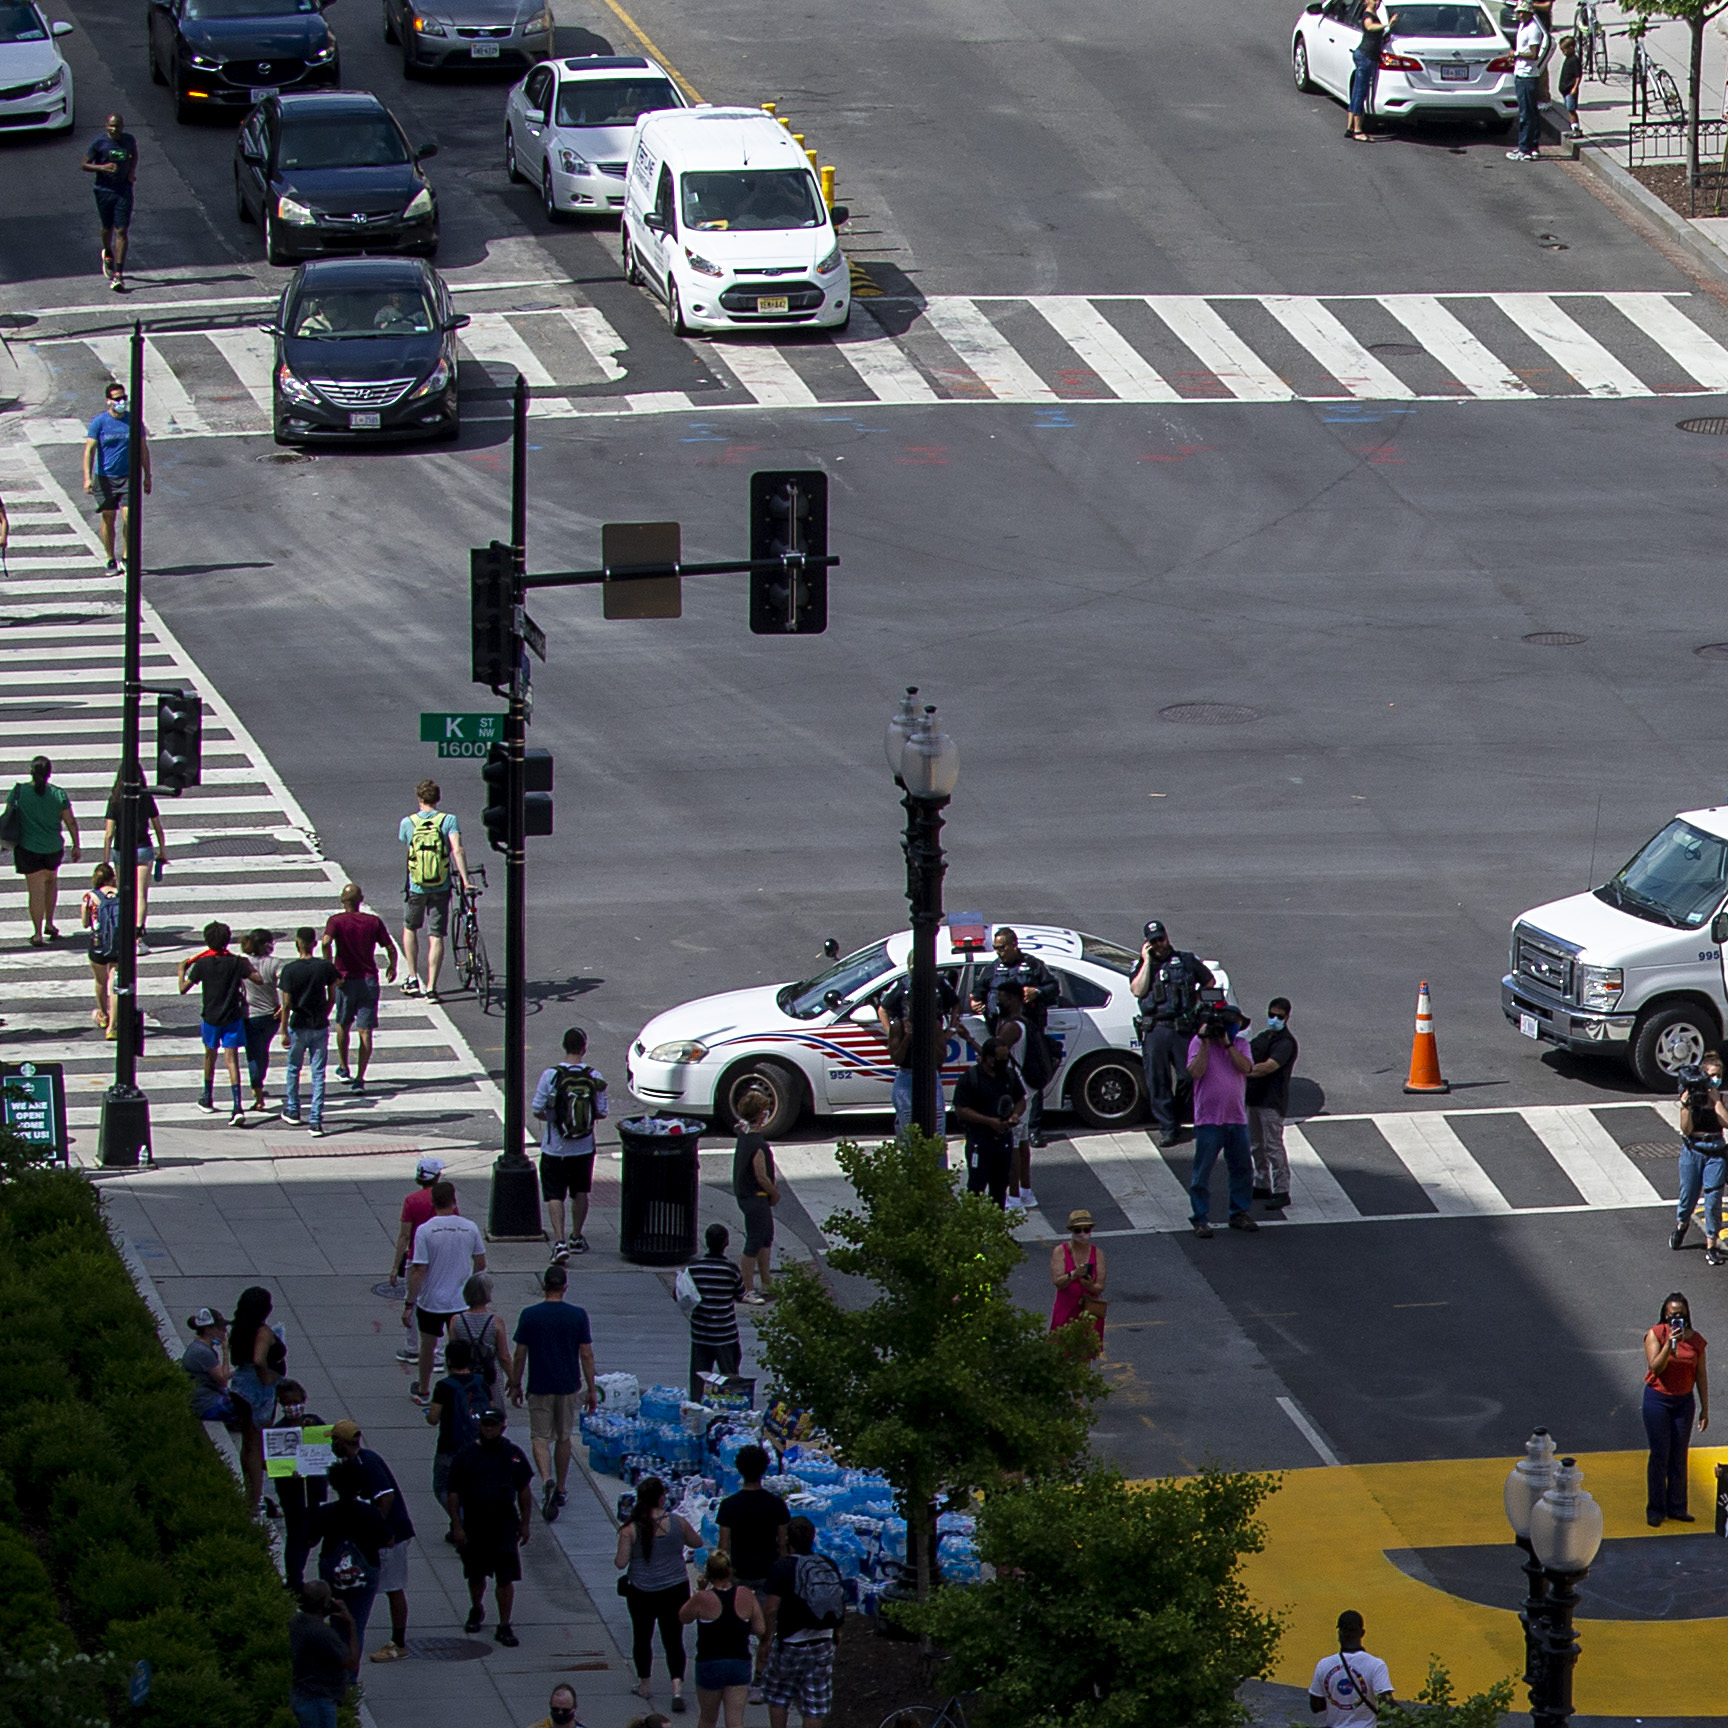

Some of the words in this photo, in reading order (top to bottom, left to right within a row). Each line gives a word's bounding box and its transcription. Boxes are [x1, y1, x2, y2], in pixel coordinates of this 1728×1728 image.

[446, 717, 464, 738] K
[480, 718, 494, 728] ST
[478, 728, 495, 738] NW
[440, 742, 486, 756] 1600
[1698, 951, 1720, 962] 995
[830, 1071, 853, 1080] 952
[11, 1101, 26, 1111] WE
